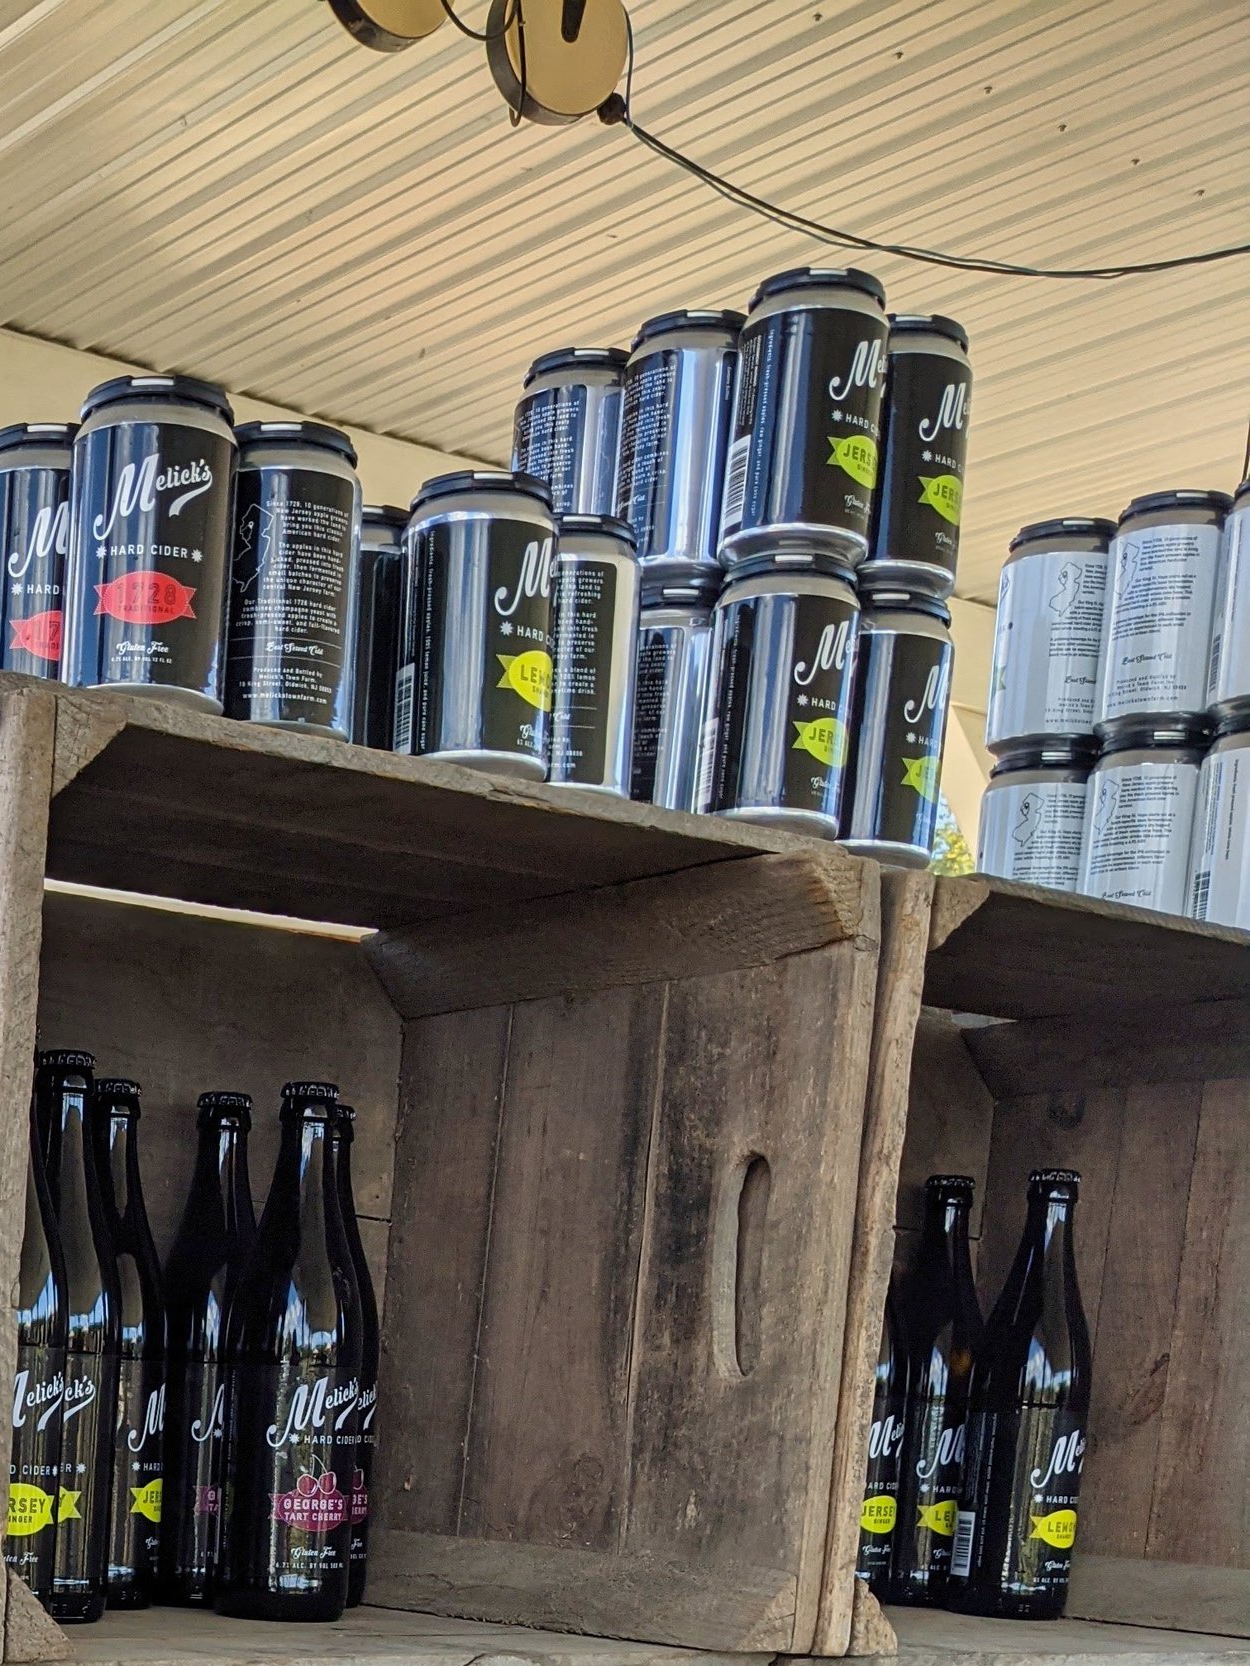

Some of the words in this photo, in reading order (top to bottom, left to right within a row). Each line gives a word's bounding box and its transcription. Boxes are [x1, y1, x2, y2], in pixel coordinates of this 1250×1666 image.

[846, 413, 869, 429] HARD
[935, 453, 957, 468] HARD
[93, 453, 213, 540] Melick's
[111, 544, 143, 556] HARD
[151, 545, 188, 559] CIDER
[27, 584, 59, 595] HARD
[117, 582, 177, 605] 1728
[517, 628, 543, 642] HARD
[117, 641, 145, 655] Gluten
[148, 641, 168, 655] Free
[811, 697, 836, 711] HARD
[266, 1376, 359, 1448] Melick's
[304, 1435, 332, 1445] HARD
[22, 1465, 51, 1476] CIDER
[8, 1497, 46, 1514] RSEY
[284, 1498, 343, 1511] GEORGE'S
[1046, 1495, 1067, 1504] HARD
[284, 1512, 308, 1522] TART
[312, 1512, 342, 1522] CHERRY
[291, 1546, 318, 1560] Gluten
